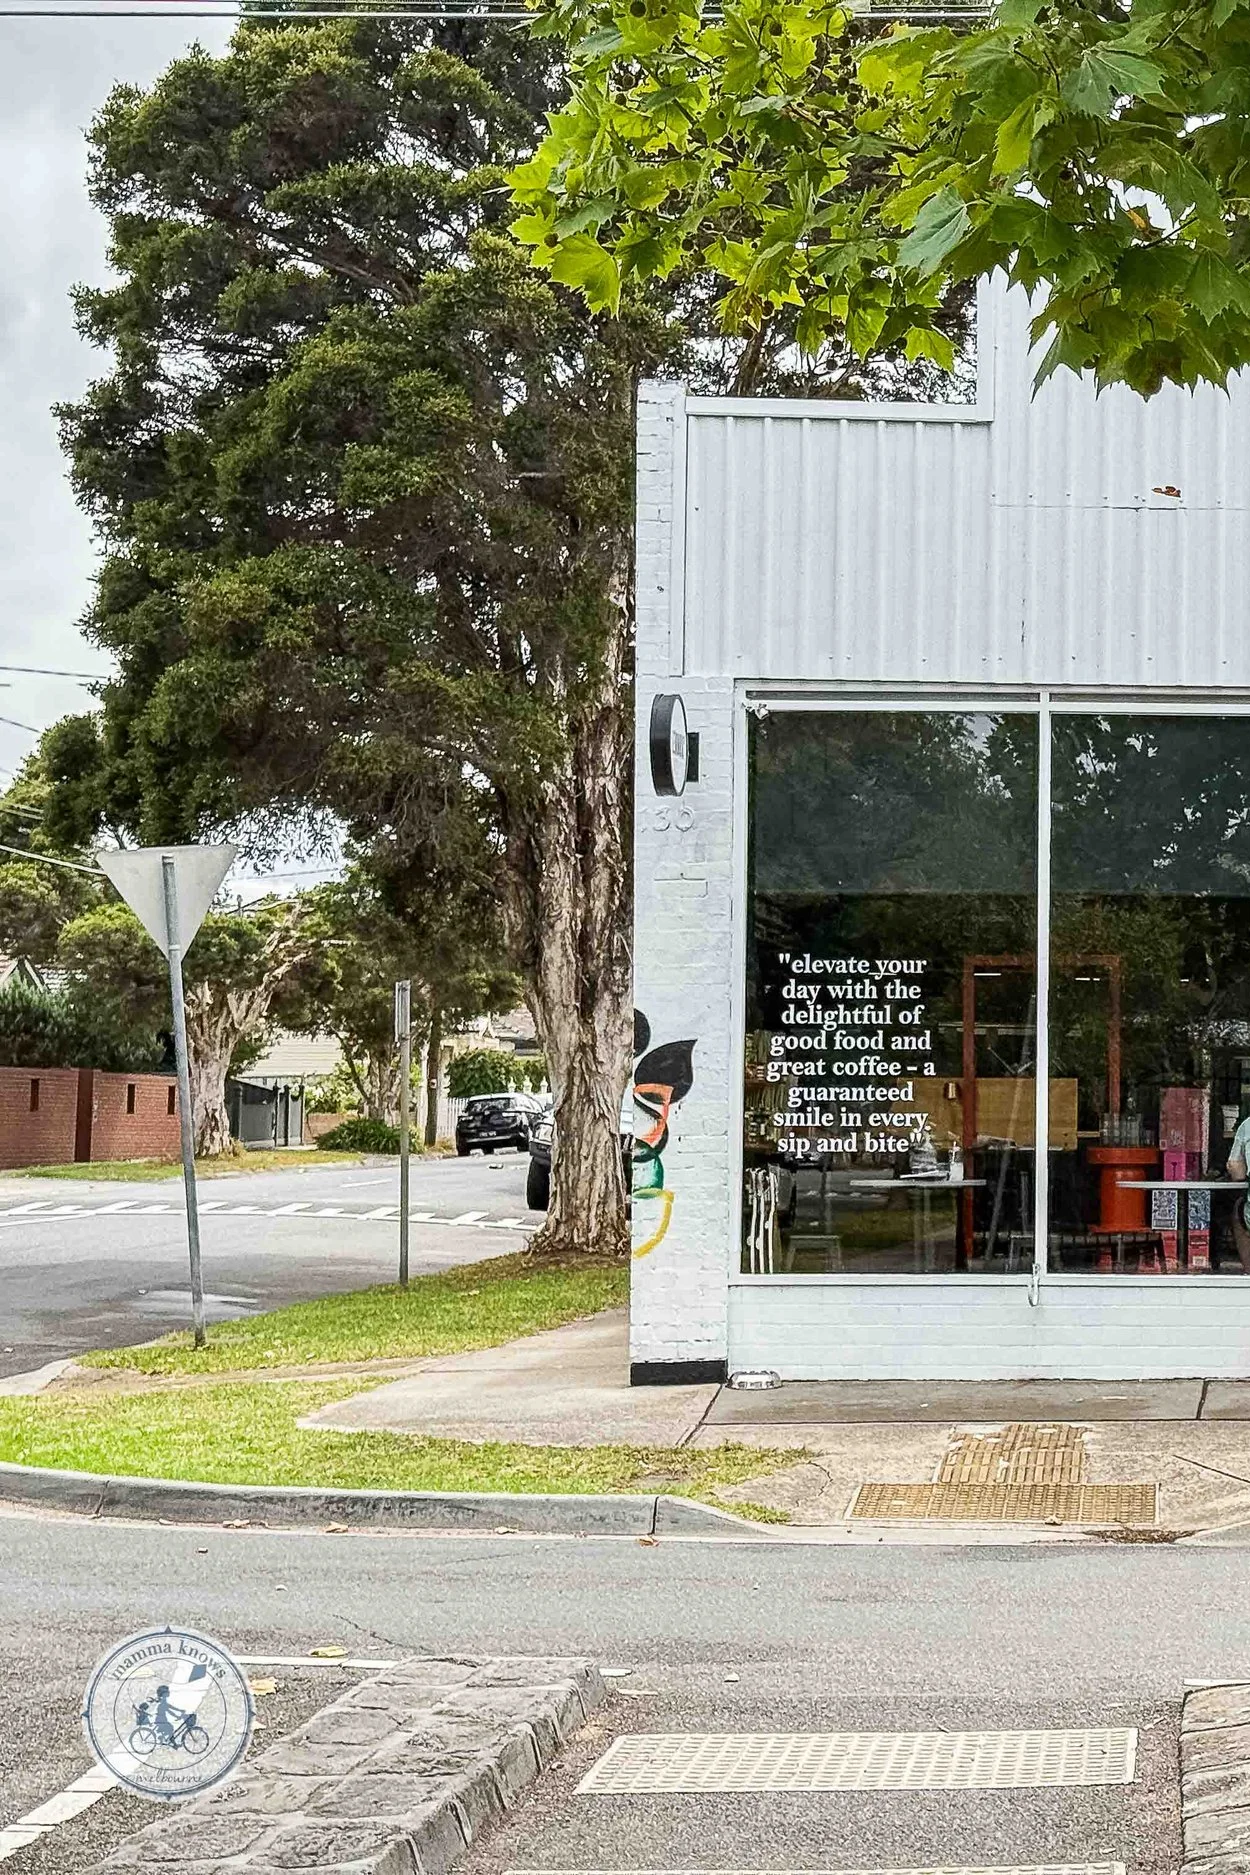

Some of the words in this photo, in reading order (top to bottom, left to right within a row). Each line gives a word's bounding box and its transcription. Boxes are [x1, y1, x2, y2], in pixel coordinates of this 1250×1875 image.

[778, 953, 870, 974] "elevate
[874, 958, 927, 980] your
[782, 979, 821, 1004] day
[827, 979, 878, 999] with
[884, 979, 921, 999] the
[781, 1005, 892, 1031] delightful
[899, 1005, 925, 1025] of
[770, 1030, 827, 1056] good
[833, 1030, 884, 1050] food
[891, 1030, 932, 1050] and
[766, 1060, 826, 1081] great
[832, 1056, 901, 1076] coffee
[923, 1061, 936, 1076] a
[787, 1081, 914, 1107] guaranteed
[773, 1107, 834, 1127] smile
[840, 1107, 862, 1127] in
[868, 1112, 929, 1132] every
[778, 1133, 810, 1159] sip
[816, 1133, 857, 1152] and
[865, 1133, 923, 1152] bite"
